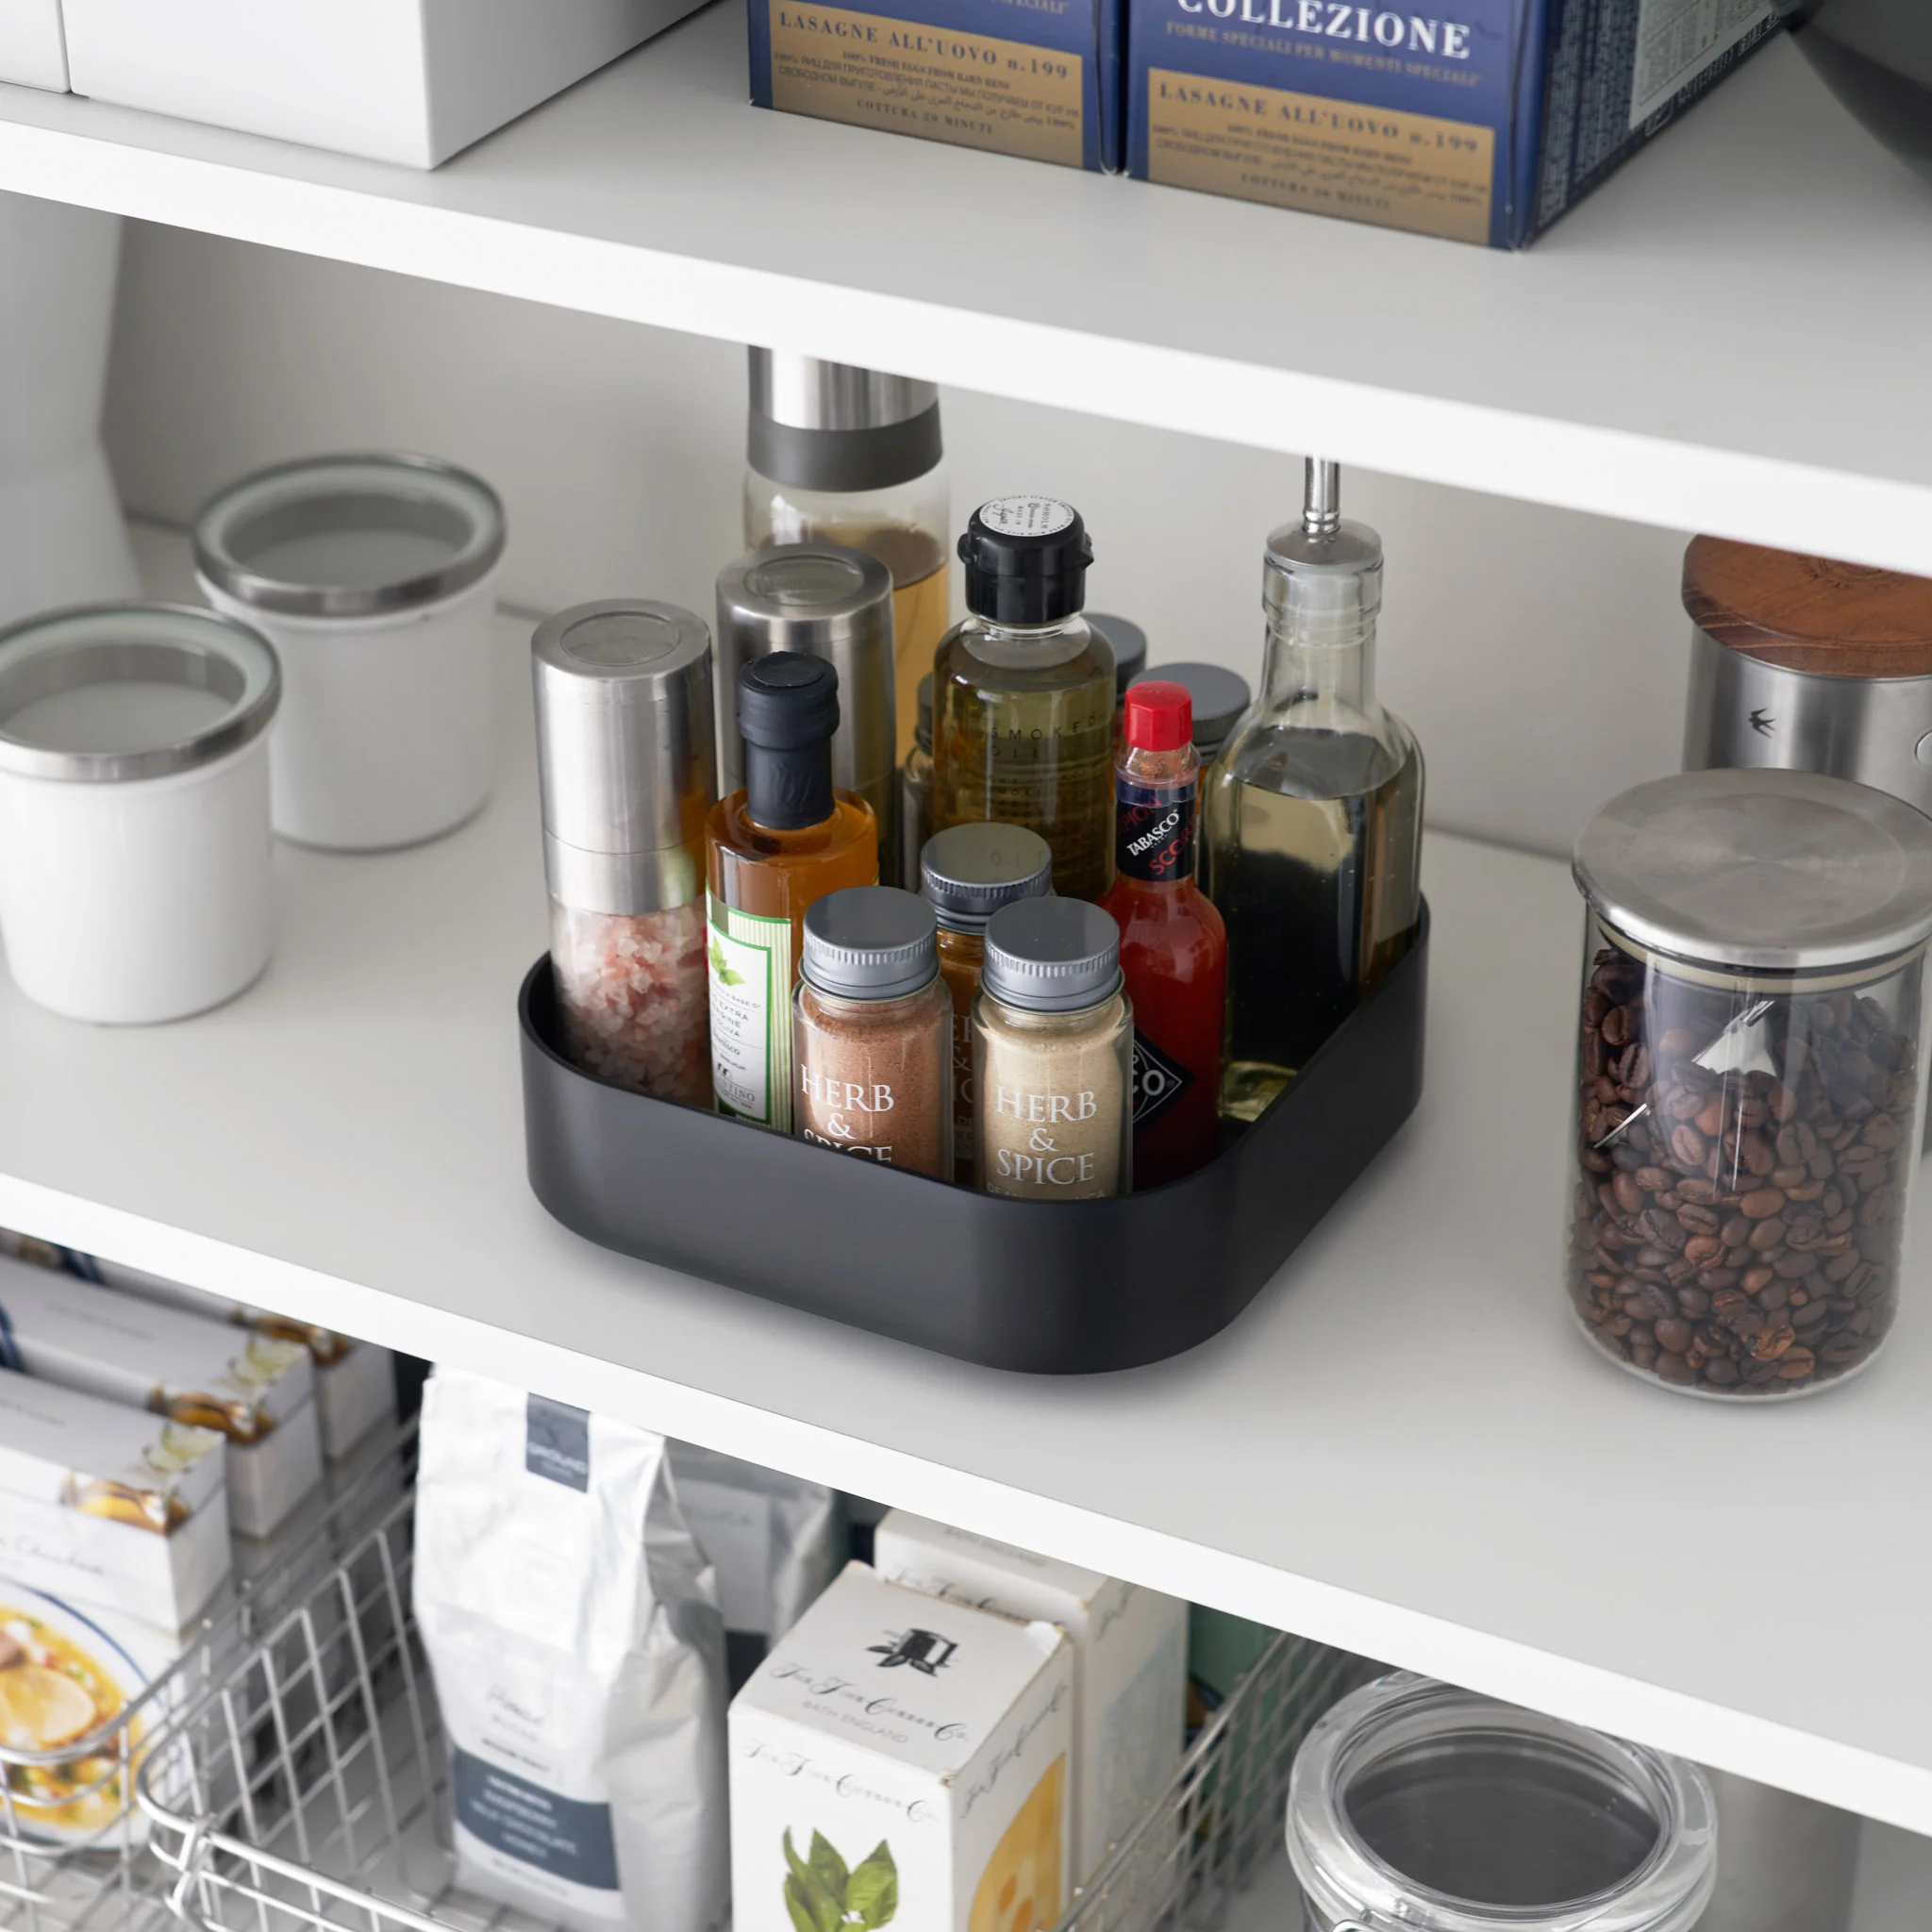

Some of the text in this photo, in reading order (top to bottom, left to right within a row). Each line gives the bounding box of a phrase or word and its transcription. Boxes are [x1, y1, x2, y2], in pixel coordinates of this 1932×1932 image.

[780, 11, 1068, 79] LASAGNE ALL'UOVO n.199
[857, 98, 918, 120] COTTURA
[1159, 82, 1269, 117] LASAGNE
[991, 711, 1097, 741] SMOKED
[991, 745, 1040, 758] OIL
[1126, 810, 1180, 857] TABASCO
[800, 1064, 895, 1113] HERB
[995, 1084, 1097, 1124] HERB
[826, 1112, 857, 1141] &
[1029, 1127, 1059, 1152] &
[996, 1148, 1095, 1186] SPICE
[801, 1699, 909, 1743] BATH ENGLAND
